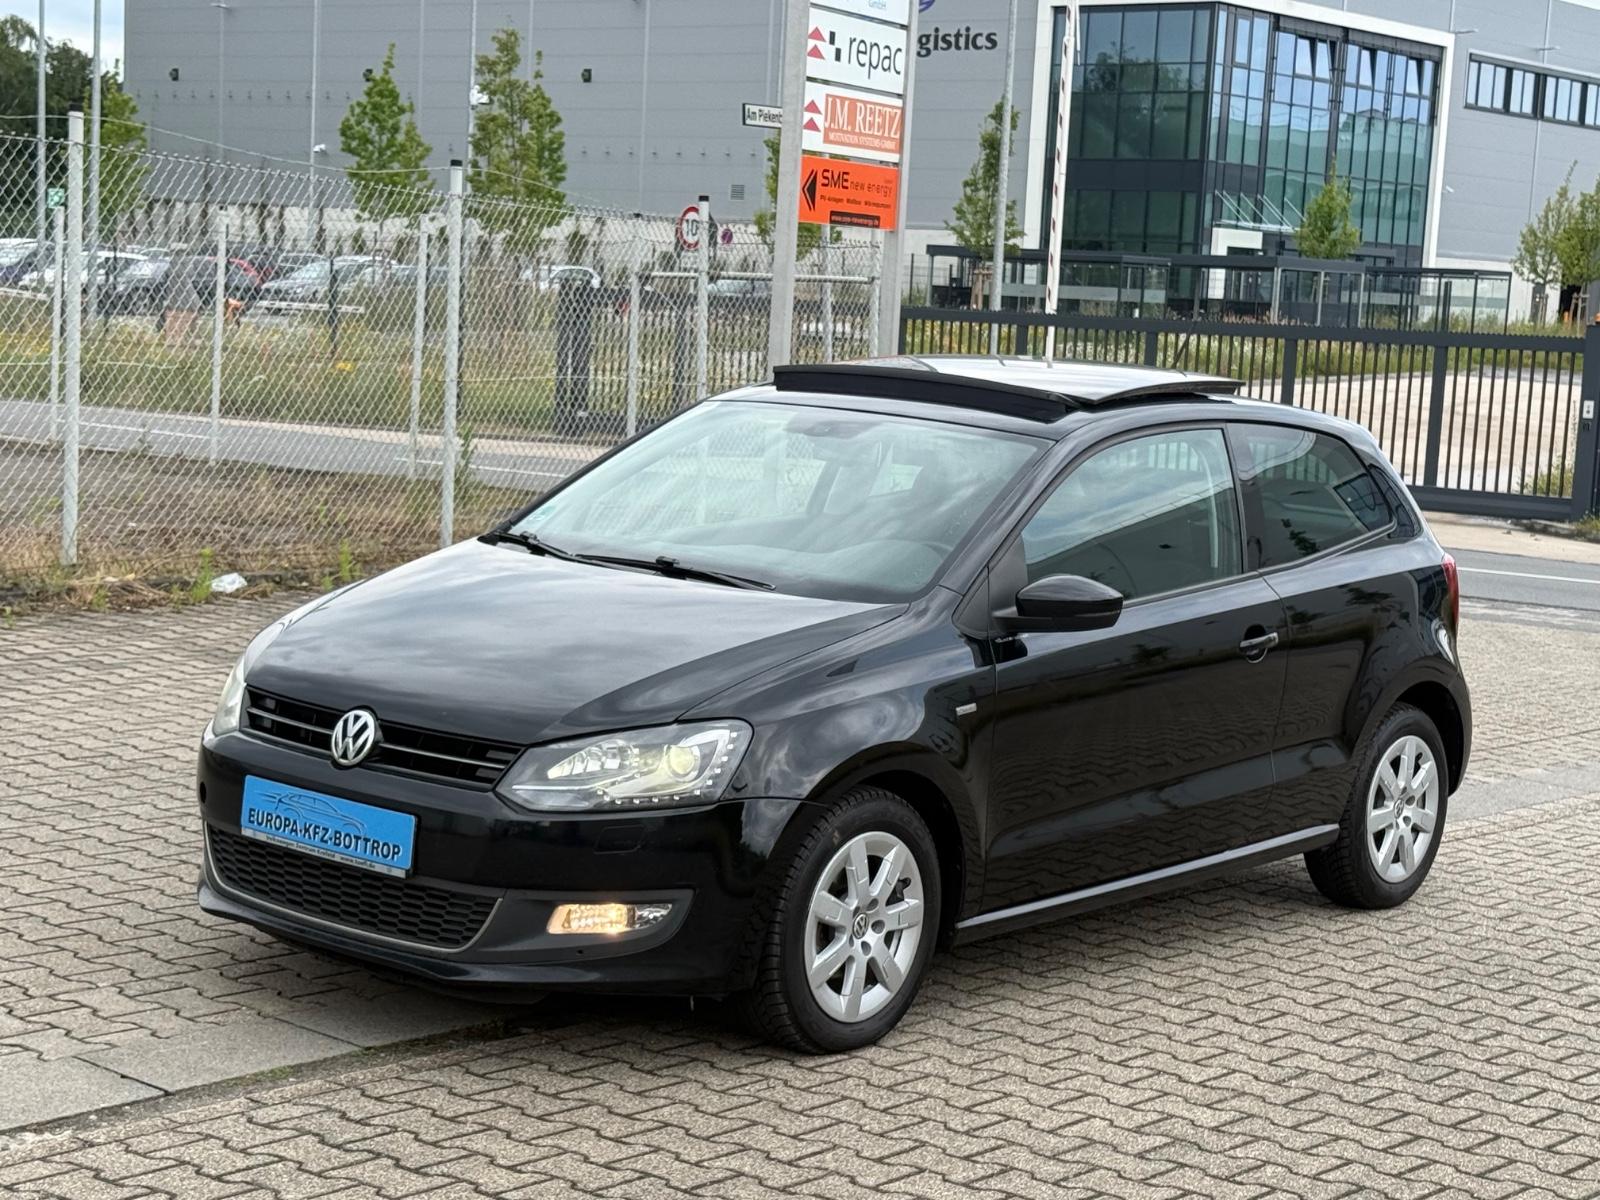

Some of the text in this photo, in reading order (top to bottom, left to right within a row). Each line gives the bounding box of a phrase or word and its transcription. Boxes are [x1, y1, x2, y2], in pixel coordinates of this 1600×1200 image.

[848, 36, 903, 79] repac
[917, 26, 998, 58] gistics
[746, 107, 757, 121] Am
[824, 96, 902, 138] J.M. REETZ
[820, 168, 893, 198] SME new energy
[248, 808, 402, 861] EUROPA-KFZ-BOTTROP
